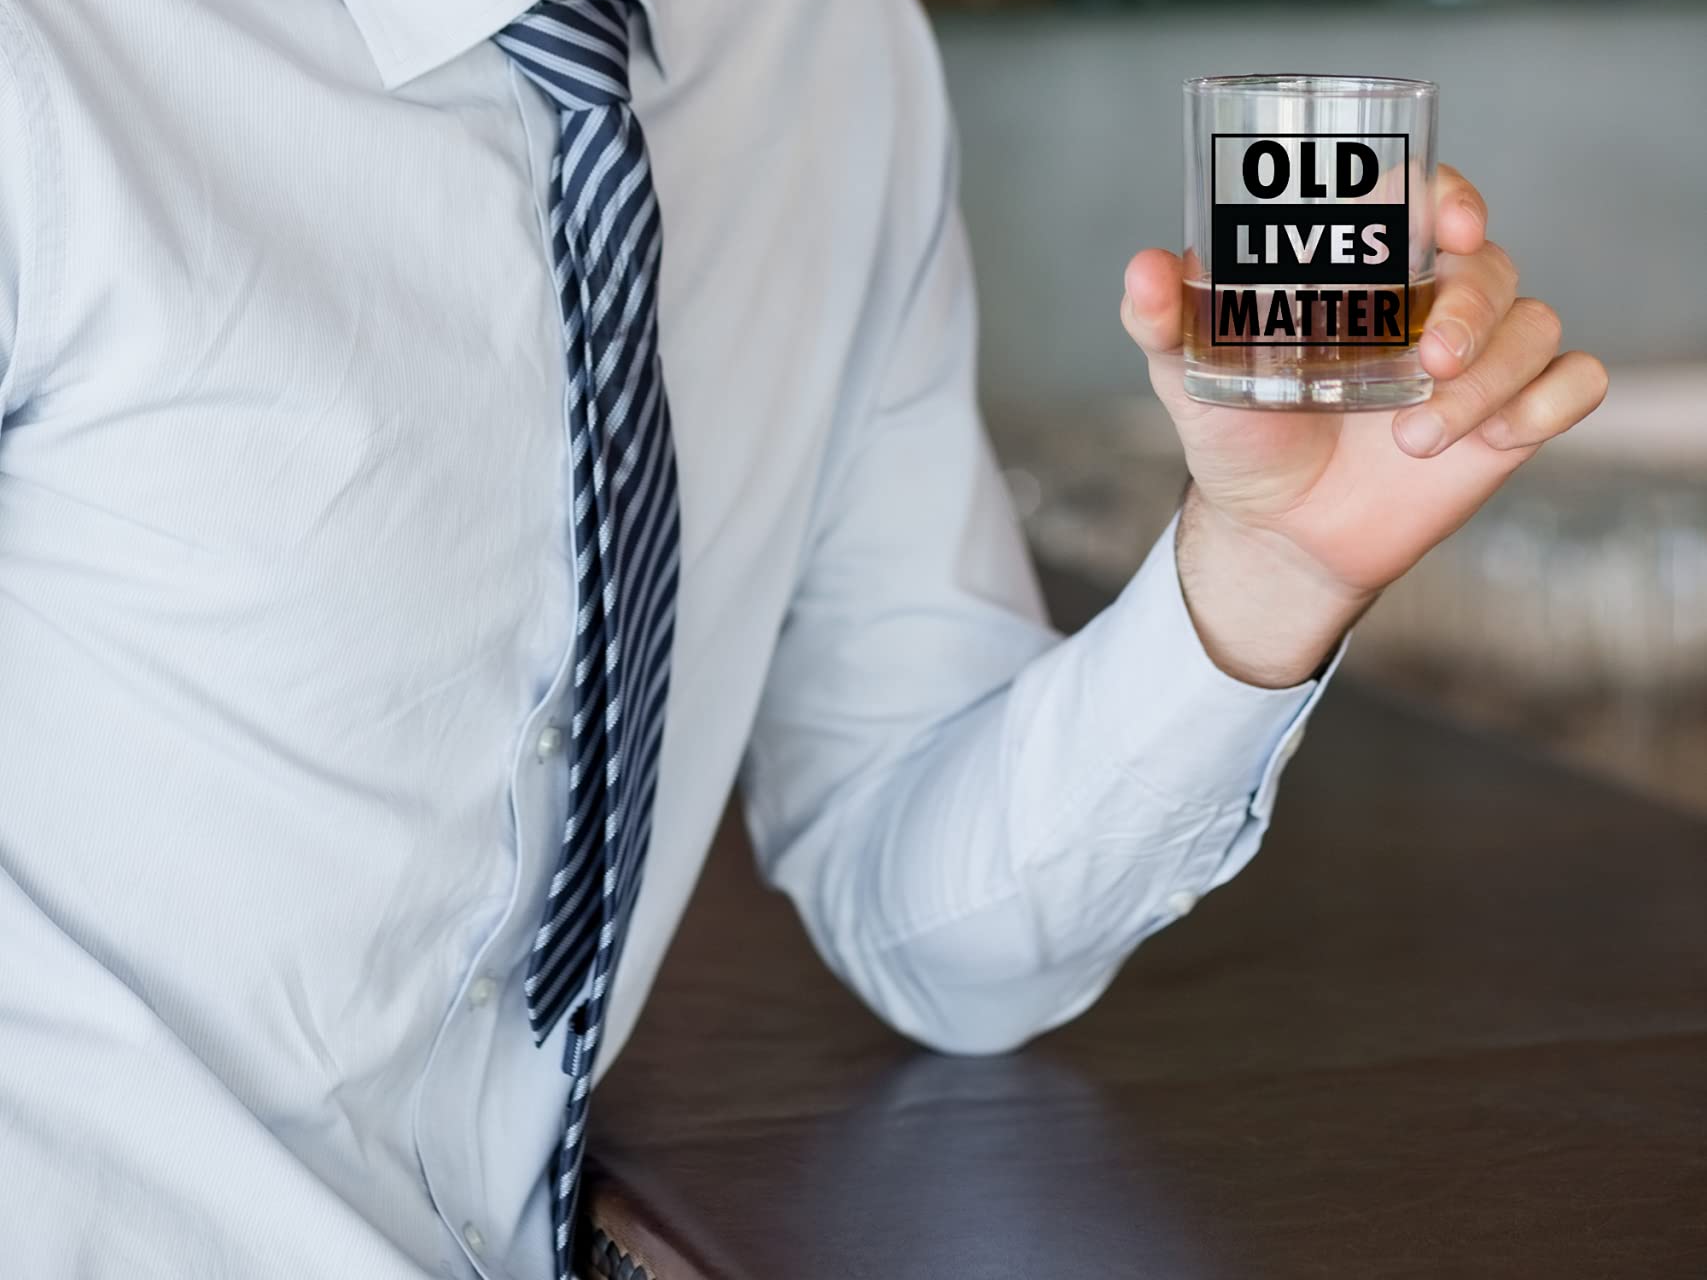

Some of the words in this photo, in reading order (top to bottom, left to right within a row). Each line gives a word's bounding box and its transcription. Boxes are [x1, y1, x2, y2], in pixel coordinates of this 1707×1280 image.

[1242, 139, 1379, 200] OLD
[1236, 223, 1390, 265] LIVES
[1218, 289, 1402, 337] MATTER
